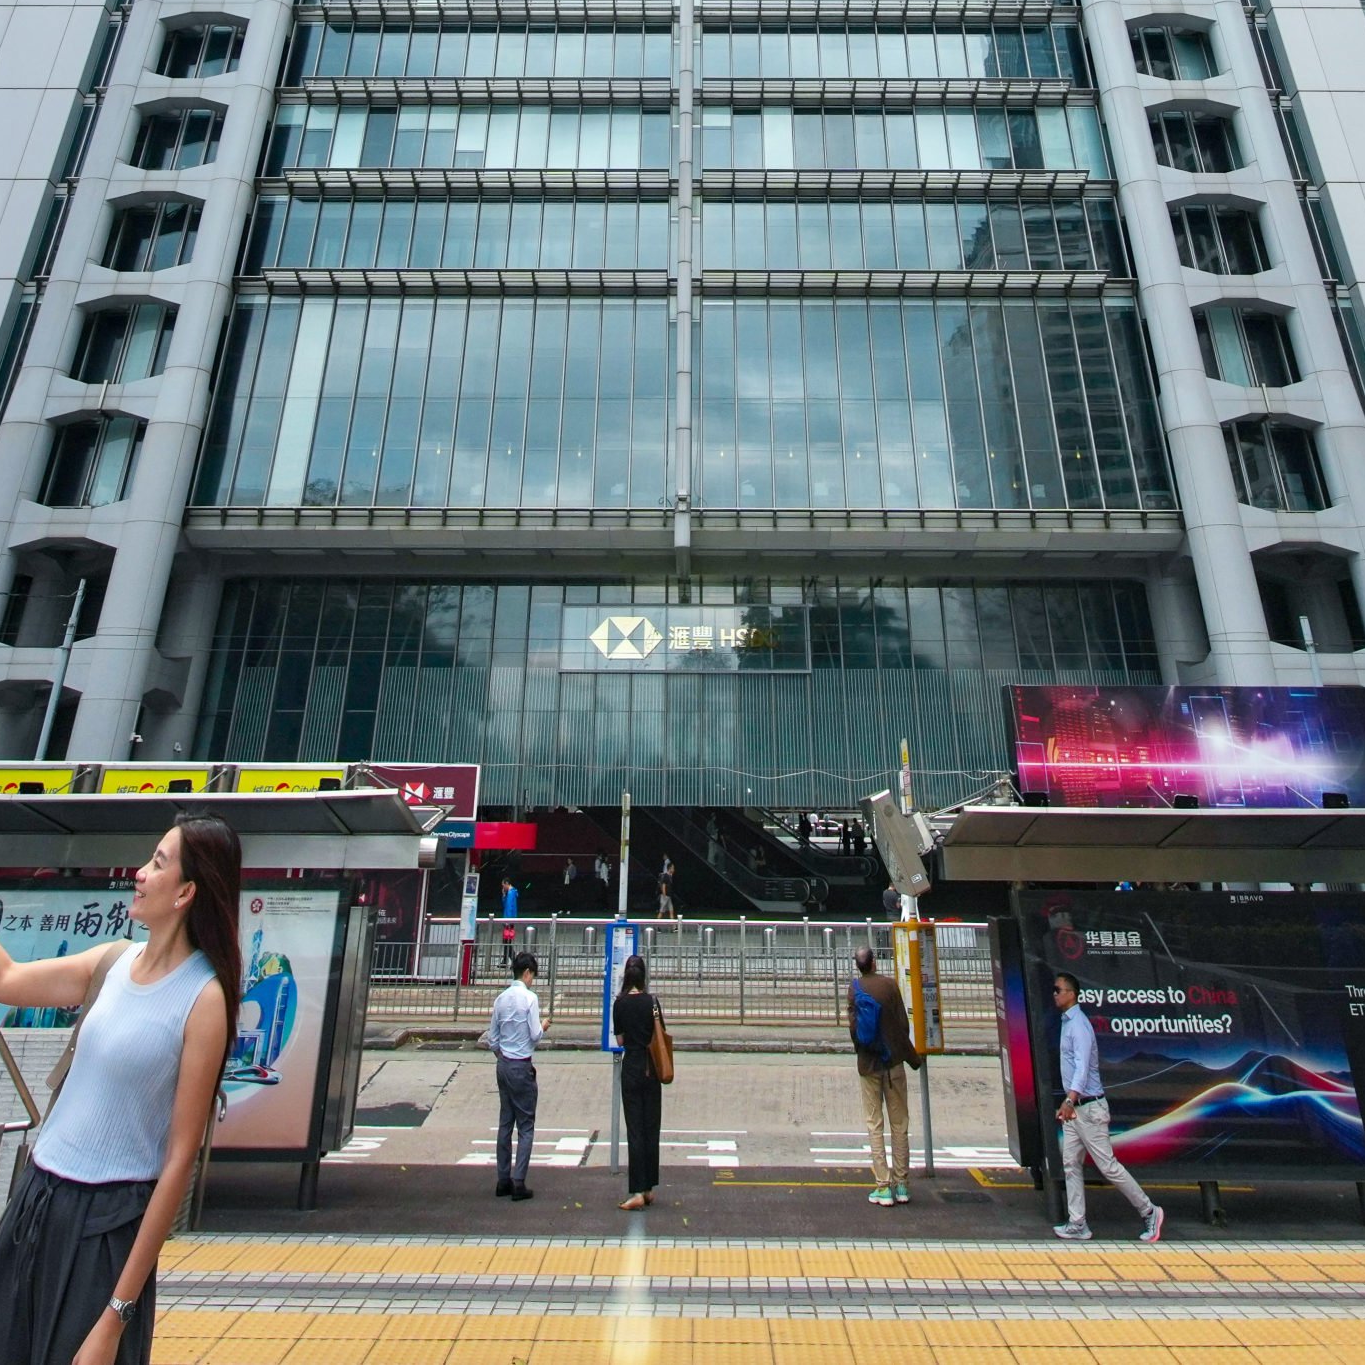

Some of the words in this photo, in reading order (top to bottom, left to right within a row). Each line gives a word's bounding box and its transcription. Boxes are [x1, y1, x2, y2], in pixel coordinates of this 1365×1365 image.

[670, 626, 714, 651] 滙豐
[720, 627, 781, 649] HSBC
[432, 786, 455, 800] 滙豐
[1084, 930, 1143, 947] 华夏基金
[1077, 988, 1104, 1008] asy
[1106, 989, 1166, 1004] access
[1167, 986, 1186, 1004] to
[1188, 985, 1239, 1006] China
[1111, 1014, 1234, 1037] opportunities?
